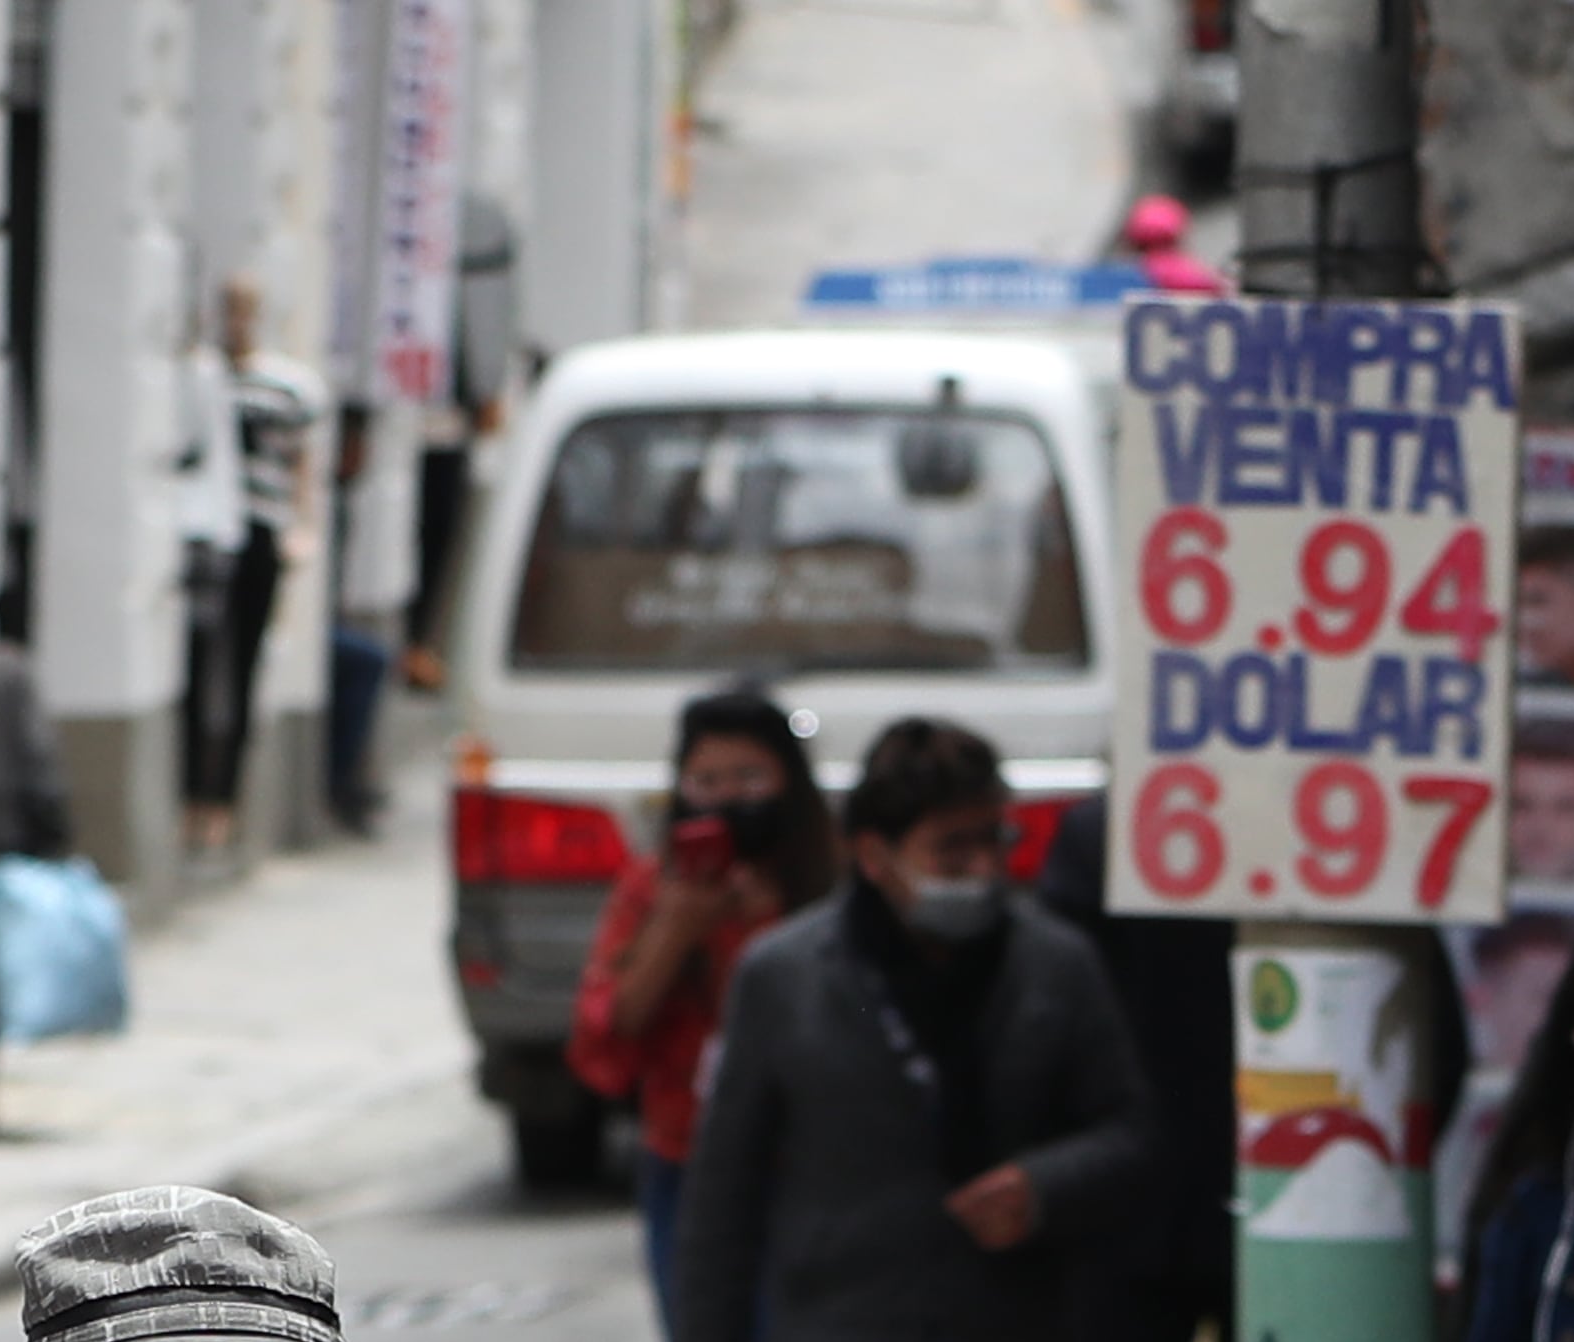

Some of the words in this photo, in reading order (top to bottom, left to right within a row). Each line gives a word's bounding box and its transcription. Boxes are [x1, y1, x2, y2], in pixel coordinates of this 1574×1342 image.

[1125, 301, 1517, 411] COMPRA
[1152, 401, 1469, 515] VENTA
[1138, 505, 1501, 662] 6.94
[1148, 649, 1488, 761] DOLAR
[1131, 762, 1494, 912] 6.97
